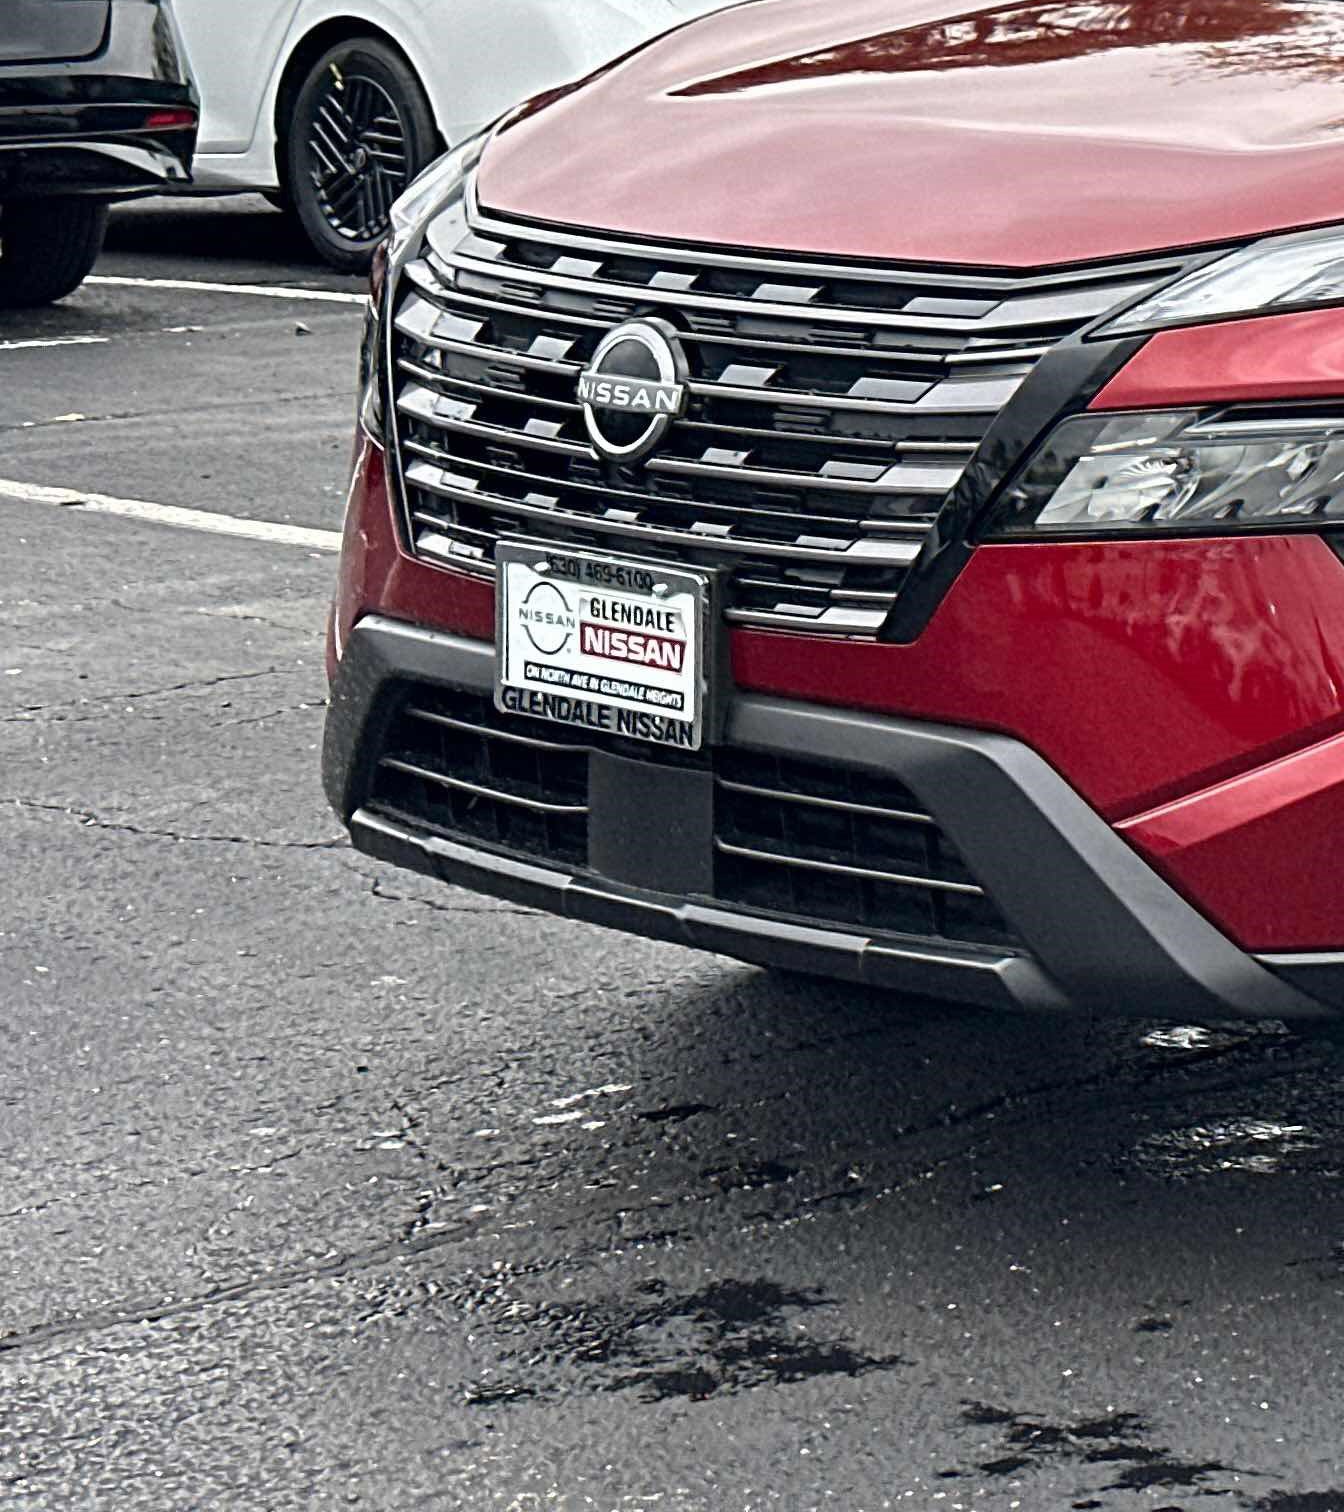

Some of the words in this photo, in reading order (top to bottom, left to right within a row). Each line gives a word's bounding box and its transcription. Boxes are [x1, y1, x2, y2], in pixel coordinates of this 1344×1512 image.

[578, 377, 679, 411] NISSAN
[518, 608, 576, 629] NISSAN
[590, 597, 676, 633] GLENDALE
[585, 627, 681, 669] NISSAN
[526, 664, 540, 678] ON
[571, 674, 589, 689] AVE
[600, 679, 645, 700] GLENDALE
[502, 689, 613, 729] GLENDALE
[617, 709, 693, 746] NISSAN
